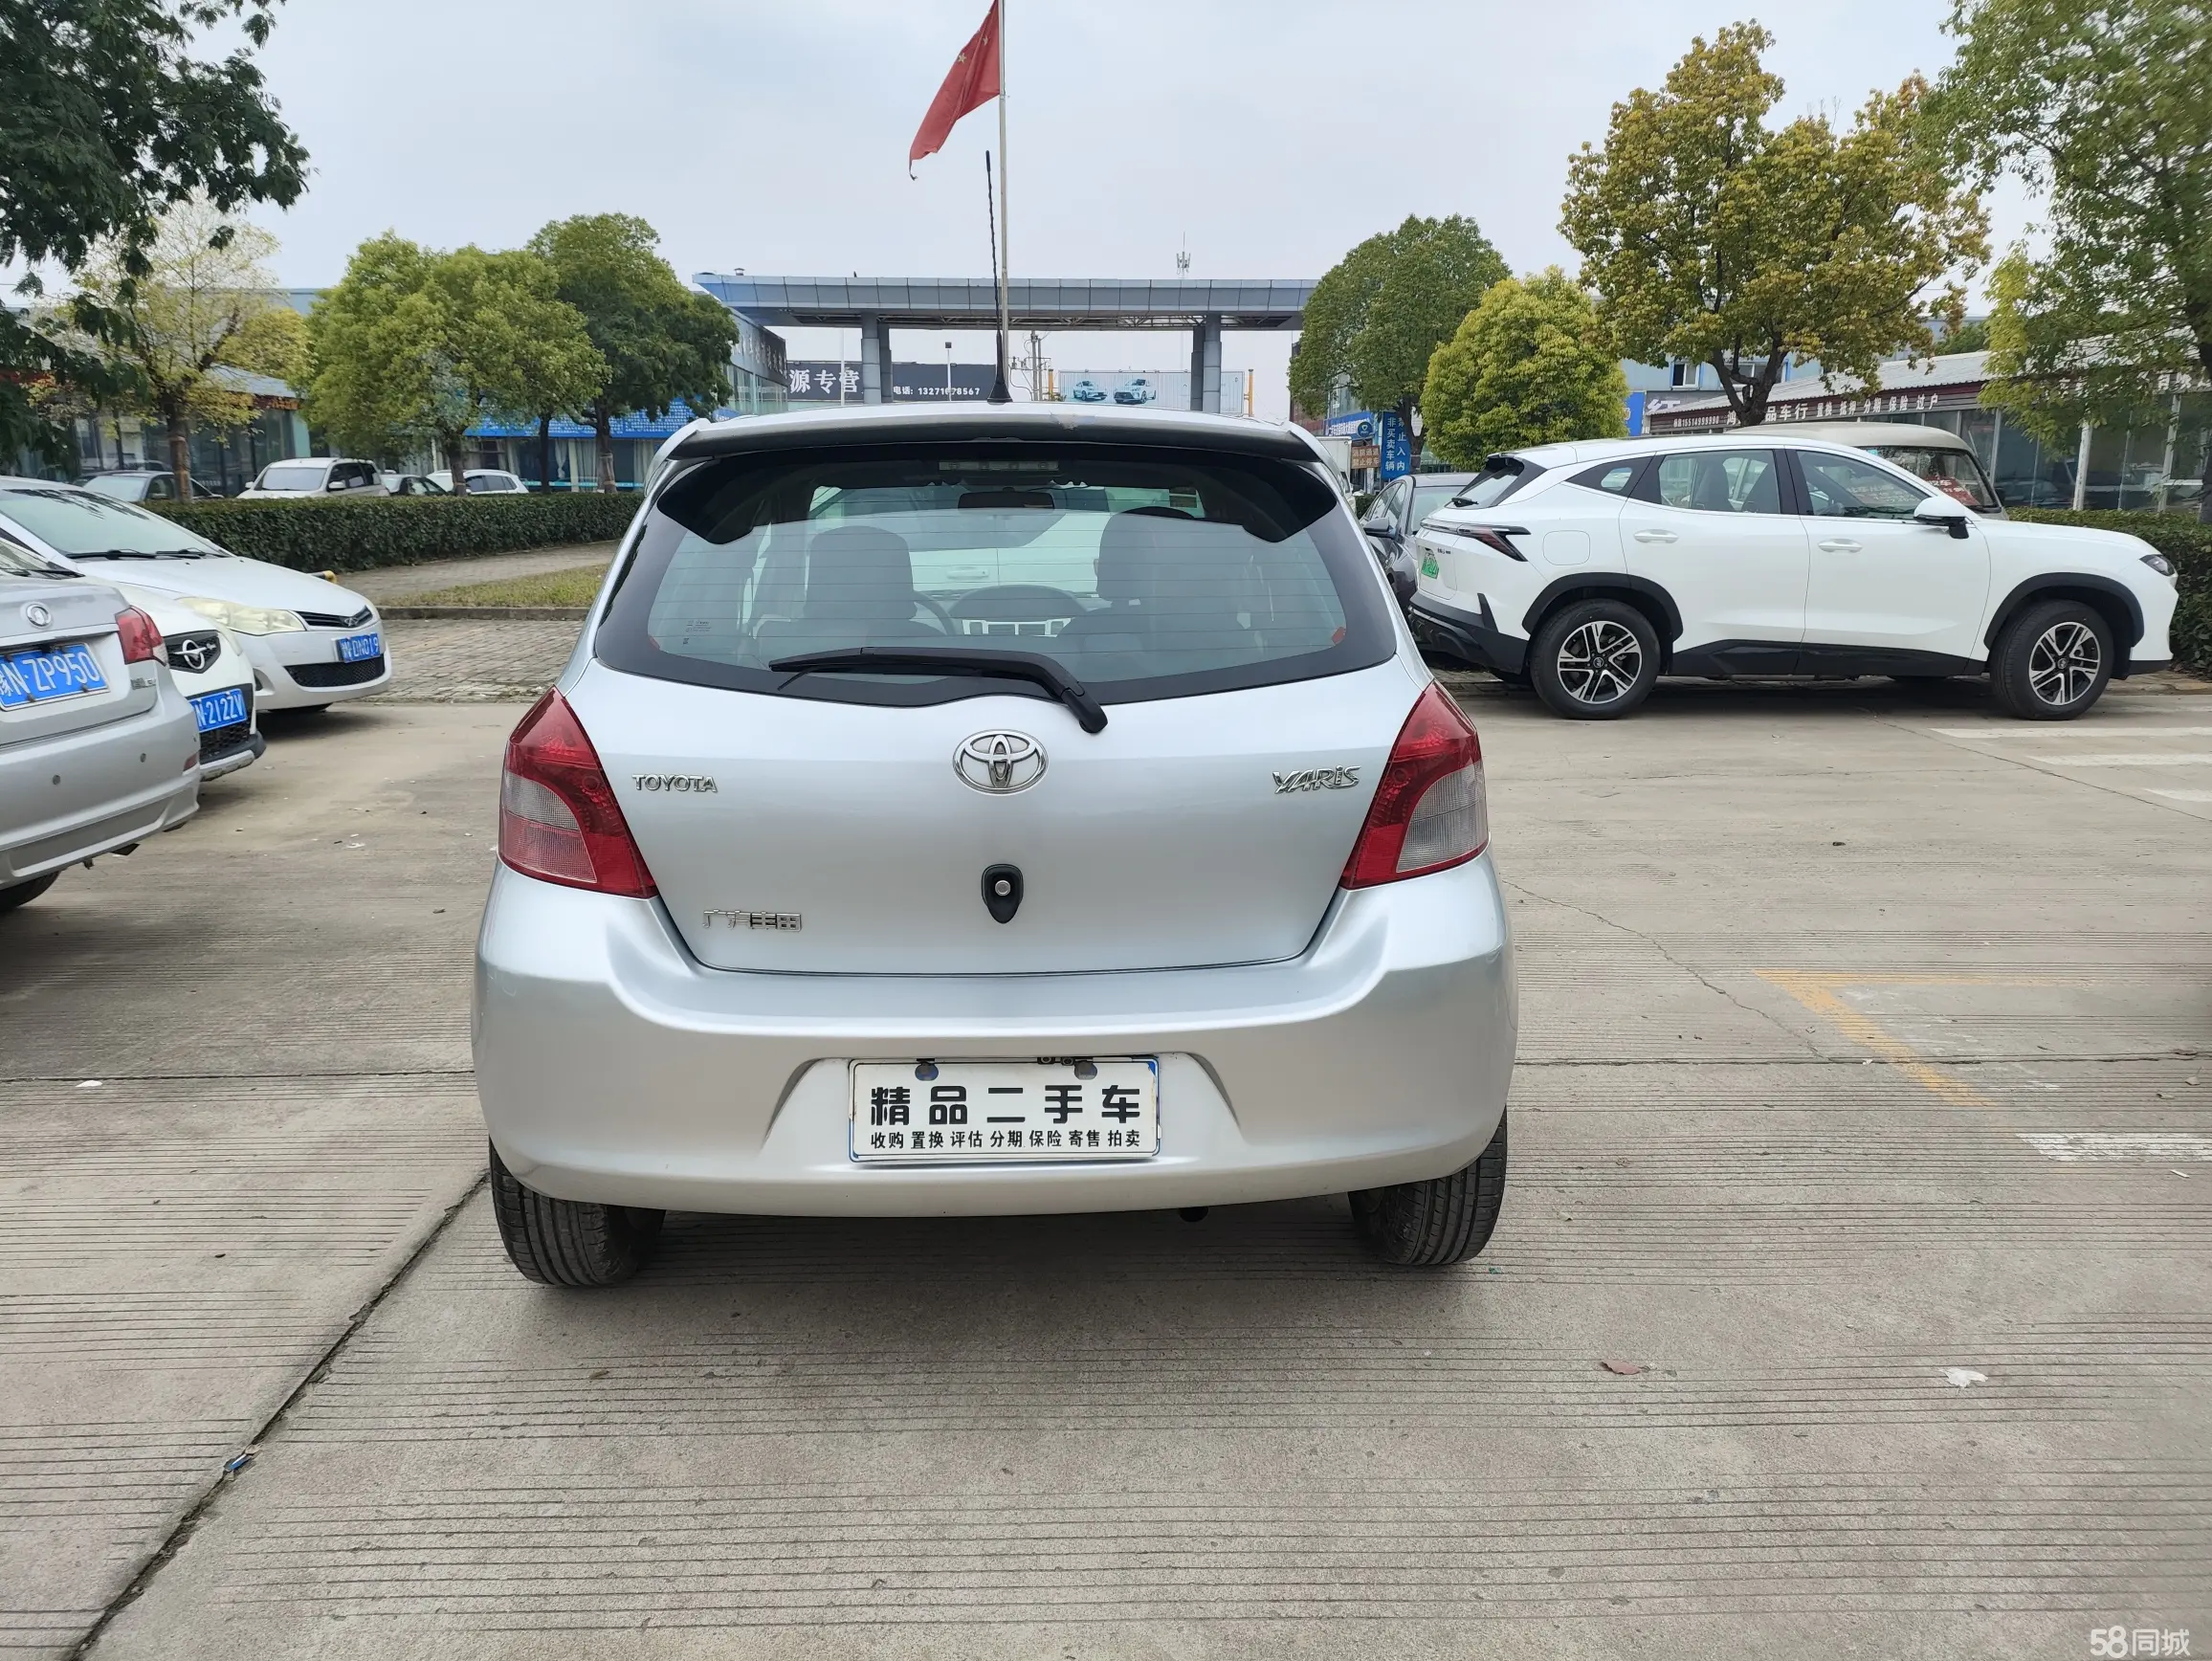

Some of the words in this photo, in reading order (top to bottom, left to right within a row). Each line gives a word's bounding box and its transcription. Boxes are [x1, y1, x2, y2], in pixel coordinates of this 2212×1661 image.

[1863, 397, 1881, 413] 分期
[1889, 395, 1908, 411] 保险
[1916, 393, 1938, 410] 过户
[1384, 417, 1397, 472] 非买卖车辆
[631, 773, 719, 793] TOYOTA
[871, 1084, 1140, 1126] 精品二手车
[871, 1130, 904, 1149] 收购
[910, 1131, 944, 1149] 置换
[950, 1130, 984, 1148] 评估
[989, 1130, 1023, 1148] 分期
[1029, 1129, 1062, 1148] 保险
[1068, 1129, 1100, 1147] 寄售
[1107, 1129, 1140, 1147] 拍卖
